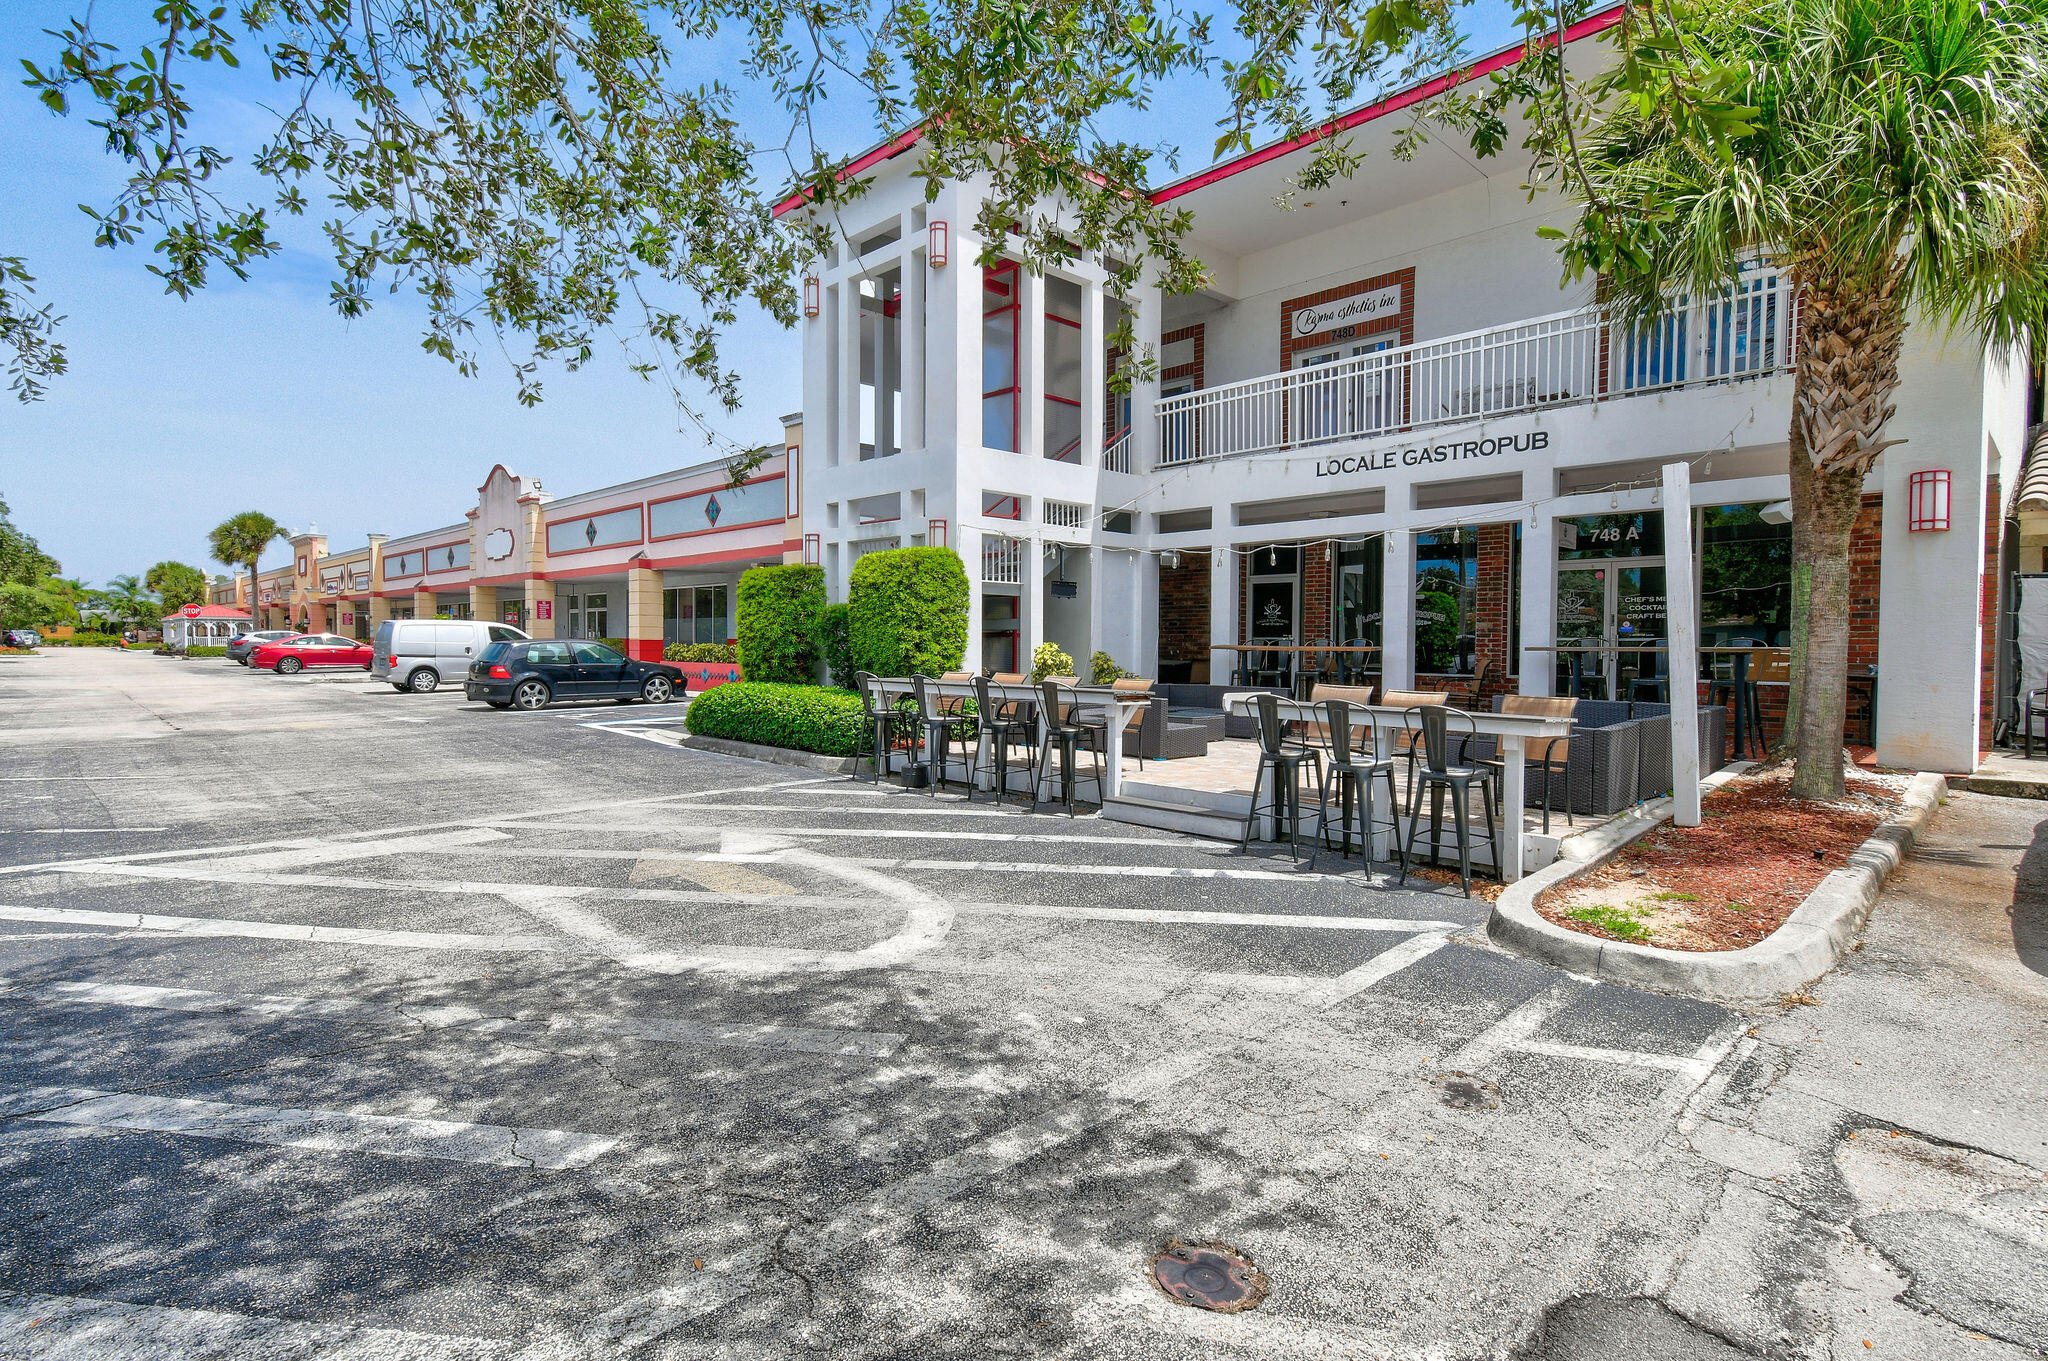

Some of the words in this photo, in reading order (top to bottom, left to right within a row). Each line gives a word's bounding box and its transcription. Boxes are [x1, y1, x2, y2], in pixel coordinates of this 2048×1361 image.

[1338, 298, 1376, 320] esthetics
[1379, 294, 1396, 308] inc
[1331, 326, 1356, 340] 748D
[1315, 452, 1397, 478] LOCALE
[1402, 431, 1549, 466] GASTROPUB
[1590, 528, 1621, 543] 748
[1625, 526, 1640, 541] A
